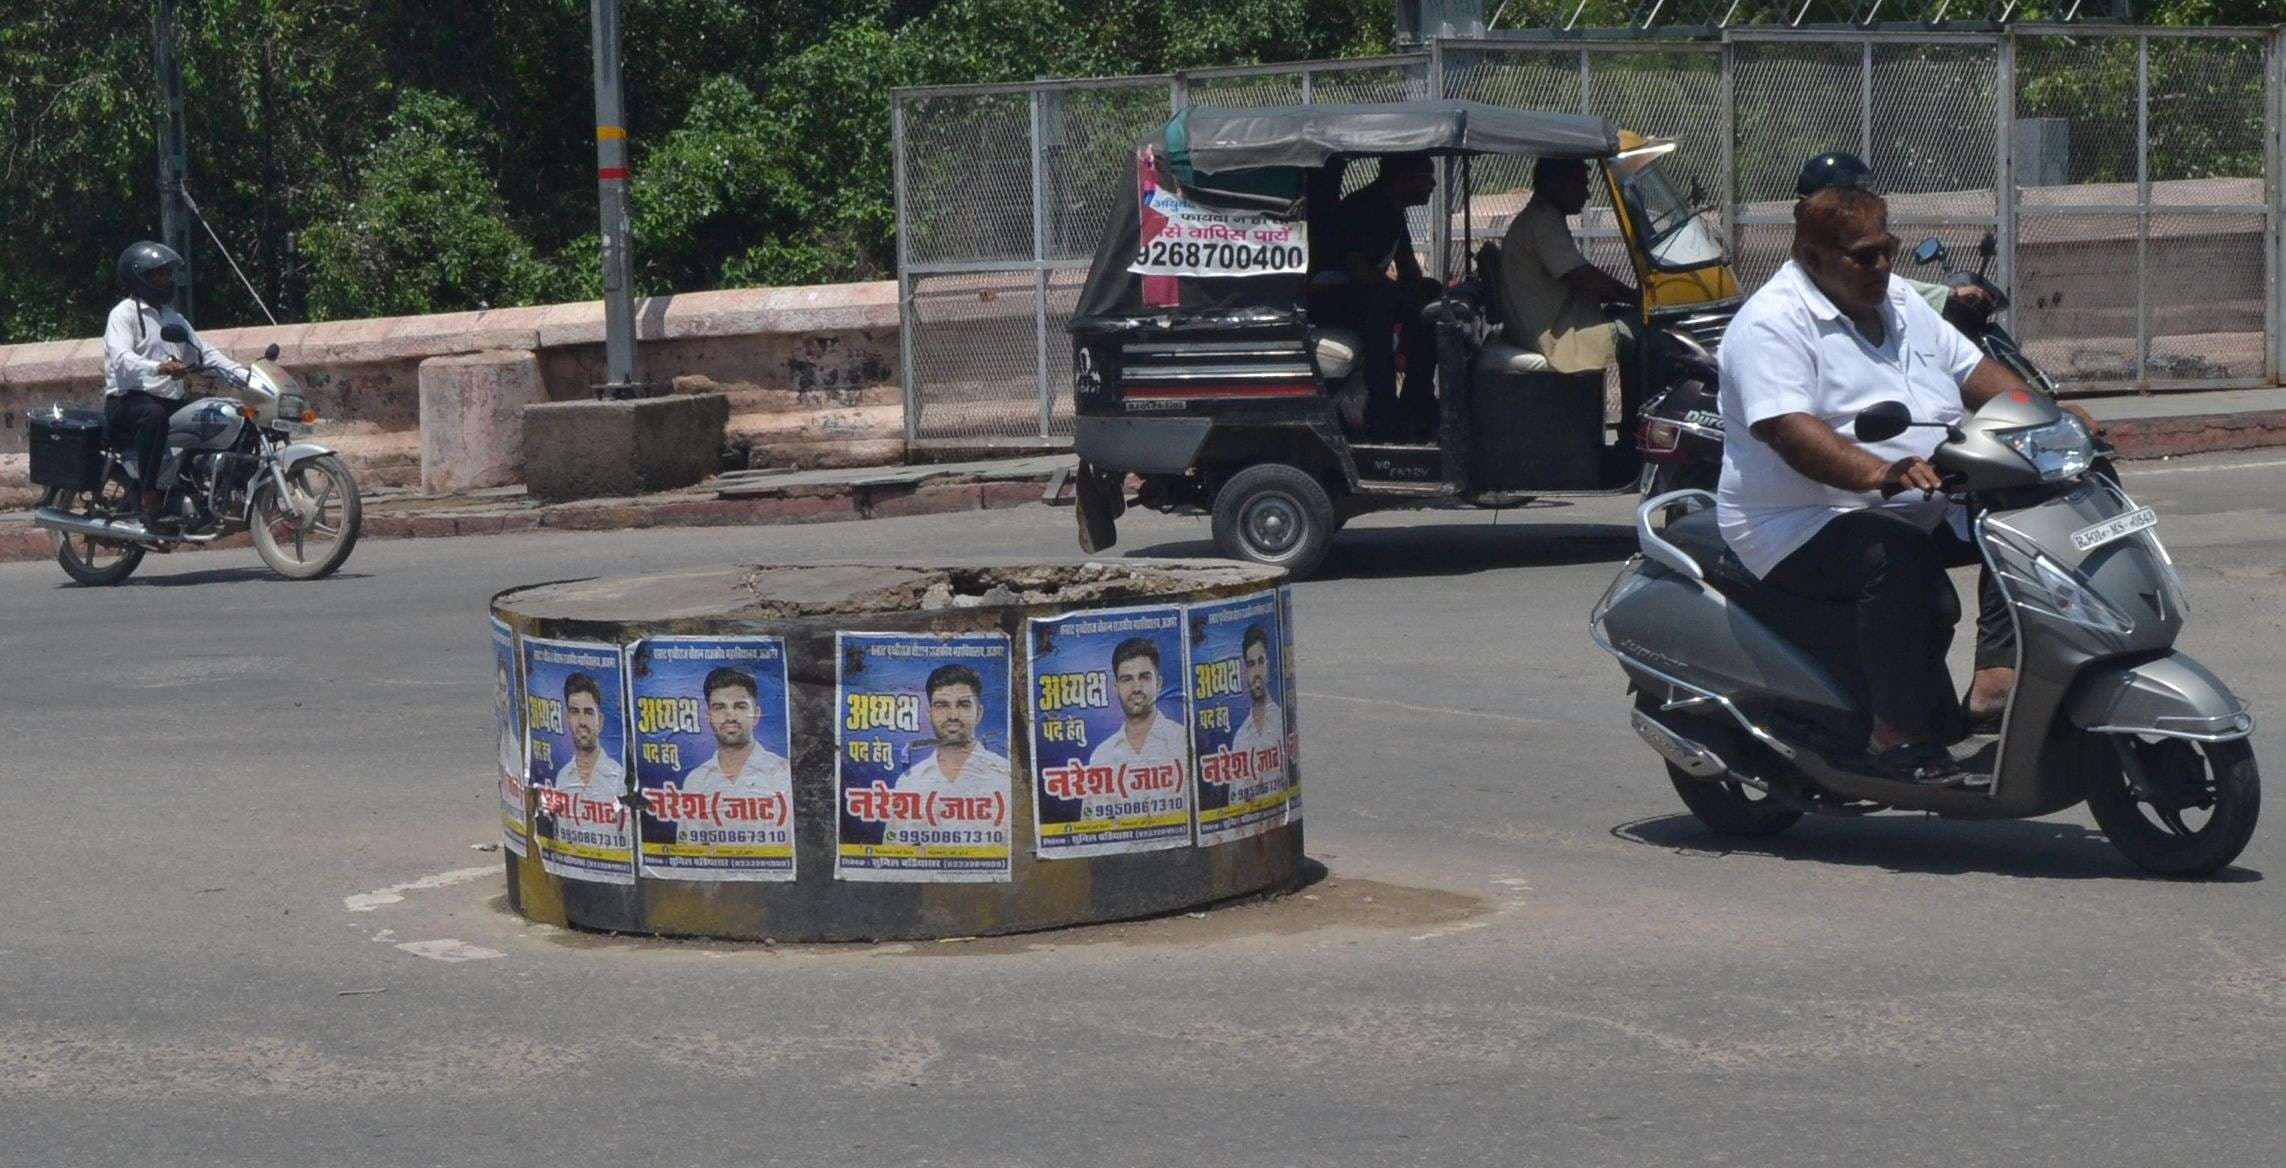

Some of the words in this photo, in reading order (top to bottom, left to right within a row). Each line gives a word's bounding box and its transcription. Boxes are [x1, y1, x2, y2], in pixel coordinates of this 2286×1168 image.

[1189, 225, 1246, 241] वापिस
[1136, 241, 1303, 270] 9268700400
[1039, 671, 1108, 711] अध्यक्ष
[1195, 657, 1242, 699] अध्यक्ष
[638, 695, 700, 735] अध्यक्ष
[846, 694, 920, 732] अध्यक्ष
[1043, 719, 1062, 741] पद
[1065, 715, 1087, 747] हेतु
[643, 743, 659, 764] पद
[848, 741, 868, 762] पद
[871, 736, 894, 770] हेतु
[1202, 747, 1249, 783] नरेश
[1046, 762, 1115, 797] नरेश
[848, 784, 922, 821] नरेश
[1095, 798, 1183, 817] 9950867310
[690, 830, 785, 843] 9950867310
[899, 831, 1002, 843] 9950867310
